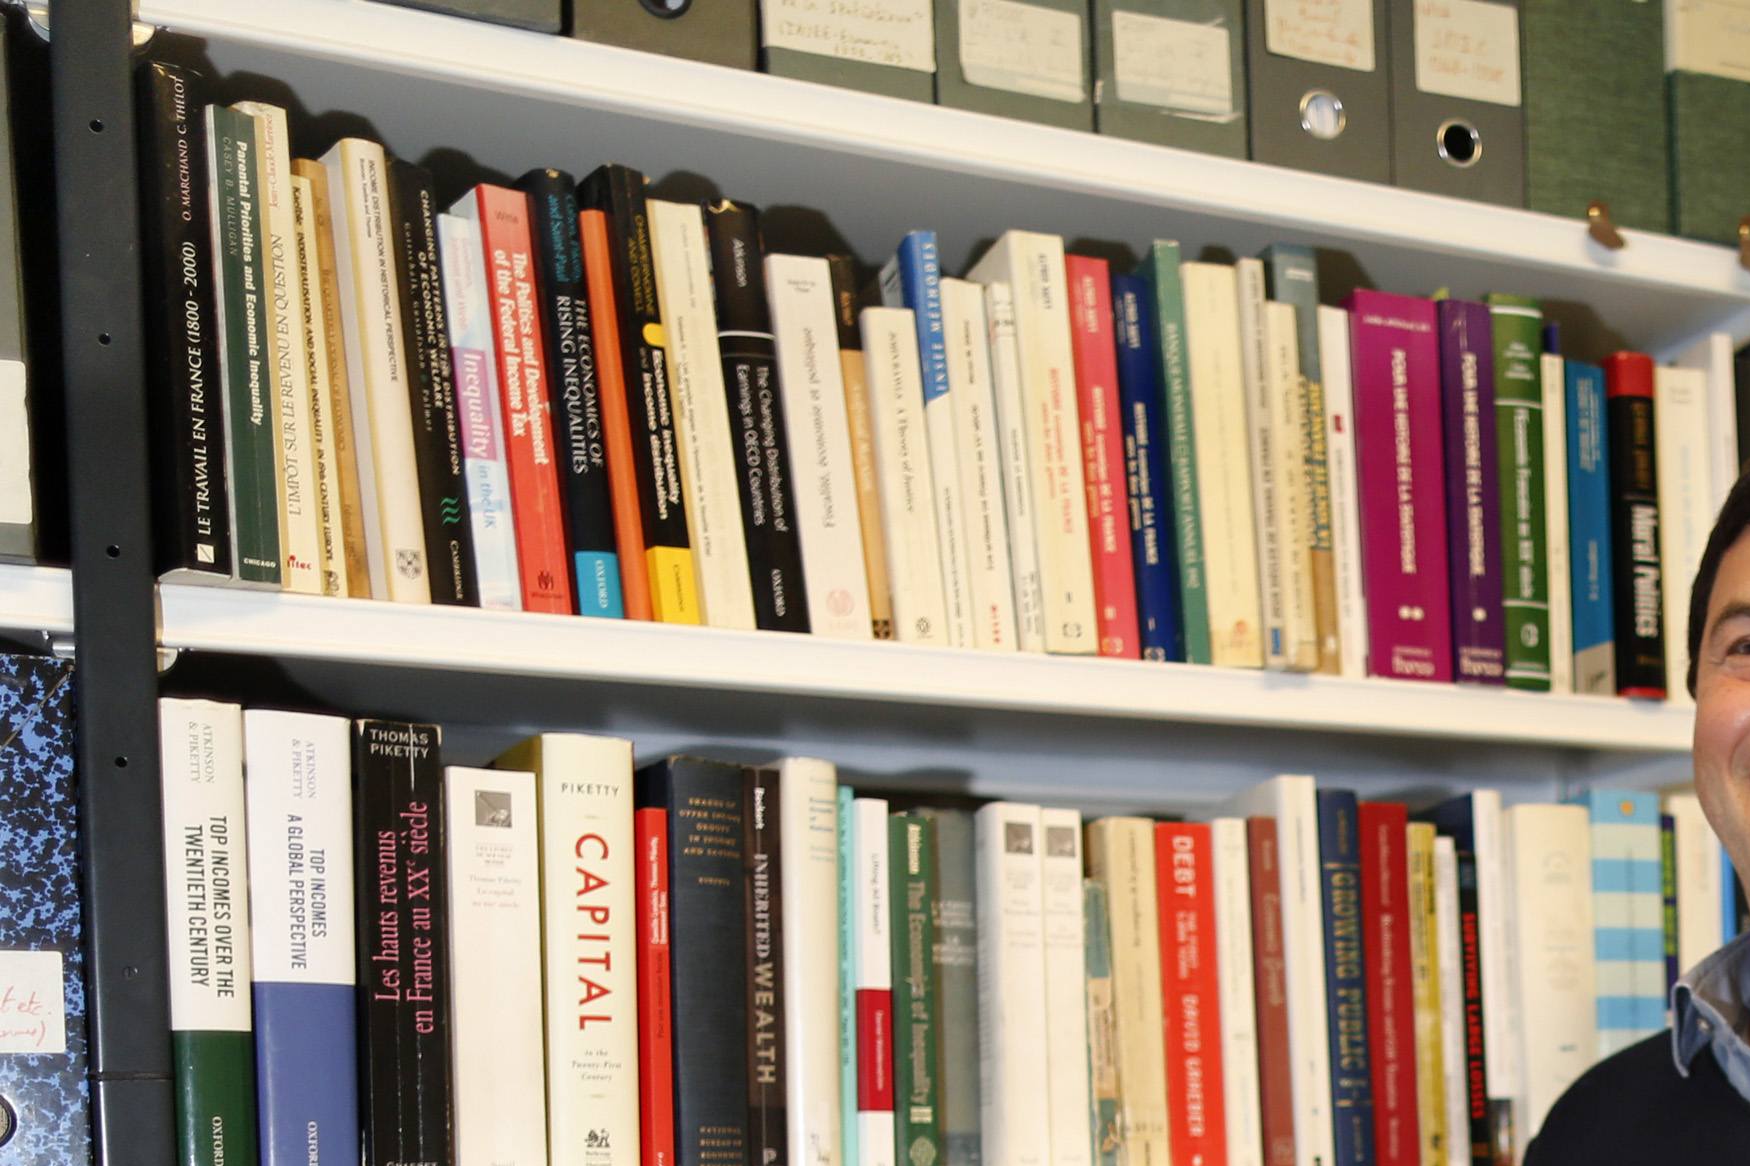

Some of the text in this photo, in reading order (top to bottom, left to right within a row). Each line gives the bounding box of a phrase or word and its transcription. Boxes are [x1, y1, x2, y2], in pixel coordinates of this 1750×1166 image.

[182, 240, 197, 287] 2000)
[236, 141, 263, 425] Parental Priorities and Economic Inequality
[269, 232, 287, 310] QUESTION
[185, 300, 200, 342] (1800
[275, 313, 288, 333] EN
[417, 253, 444, 408] OF ECONOMIC WELFARE
[419, 191, 460, 477] CHANGING PATTERNS IN THE DISTRIBUTION
[492, 249, 530, 438] of the Federal Income Tax
[187, 346, 204, 412] FRANCE
[277, 337, 293, 397] REVENU
[511, 252, 550, 465] The Politics and Development
[556, 294, 588, 474] RISING INEQUALITIES
[574, 299, 603, 467] THE ECONOMICS OF
[191, 416, 205, 439] EN
[281, 400, 294, 417] LE
[283, 421, 297, 450] SUR
[456, 352, 496, 459] Inequality
[192, 445, 209, 511] TRAVAIL
[197, 516, 211, 535] LE
[243, 558, 276, 567] CHICAGO
[595, 559, 608, 608] OXFORD
[1634, 505, 1661, 637] Moral Politics
[186, 719, 203, 785] & PIKETTY
[199, 722, 217, 784] ATKINSON
[289, 737, 304, 799] & PIKETTY
[302, 739, 318, 799] ATKINSON
[370, 728, 428, 744] THOMAS
[371, 742, 428, 759] PIKETTY
[562, 782, 619, 797] PIKETTY
[285, 813, 308, 969] A GLOBAL PERSPECTIVE
[307, 848, 328, 938] TOP INCOMES
[1172, 835, 1196, 900] DEBT
[181, 825, 212, 987] TWENTIETH CENTURY
[209, 815, 235, 998] TOP INCOMES OVER THE
[372, 830, 401, 1001] Les hauts revenus
[400, 800, 434, 1032] en France au XXe siècle
[575, 831, 613, 1032] CAPITAL
[752, 853, 776, 1084] INHERITED WEALTH
[1329, 871, 1365, 1068] GROWING PUBLIC
[1181, 994, 1206, 1137] DAVID GRAEBER
